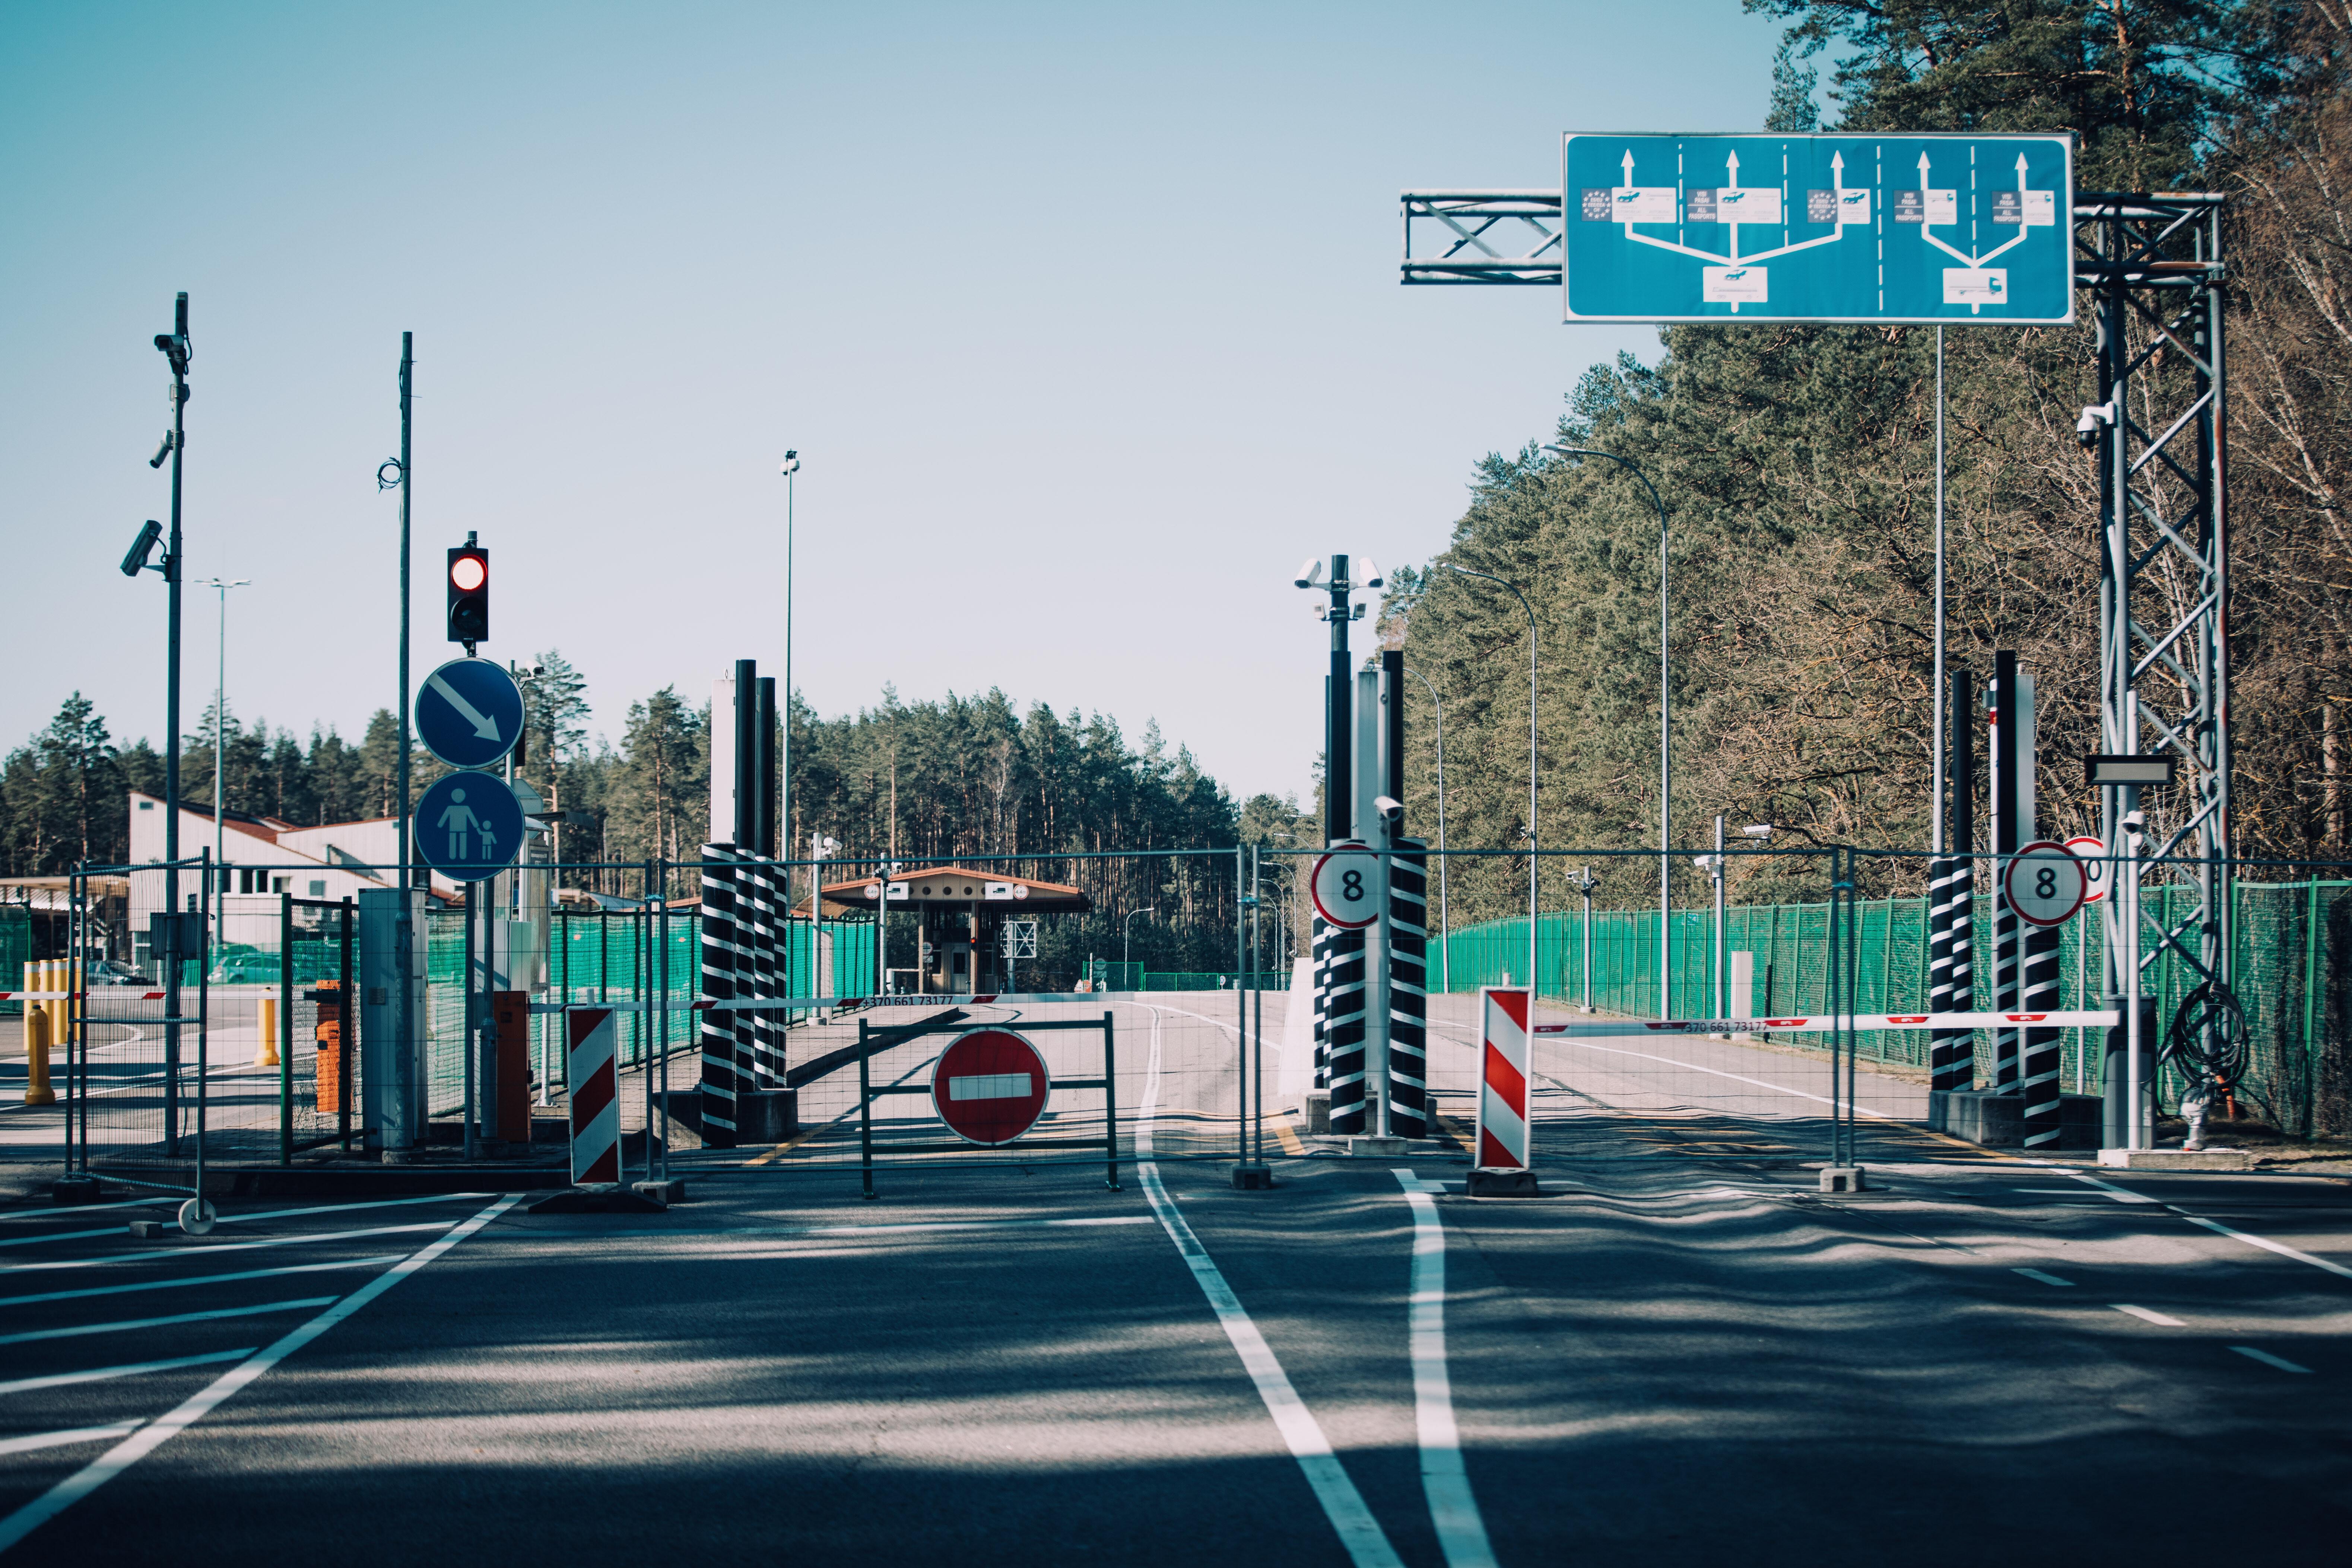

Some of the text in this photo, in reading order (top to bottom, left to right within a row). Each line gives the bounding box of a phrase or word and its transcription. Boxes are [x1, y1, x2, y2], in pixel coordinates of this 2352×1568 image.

[2086, 858, 2102, 882] 0
[1342, 870, 1364, 902] 8
[2035, 868, 2056, 899] 8
[863, 996, 953, 1006] +370 661 73177
[1681, 1022, 1768, 1032] 370 661 73177
